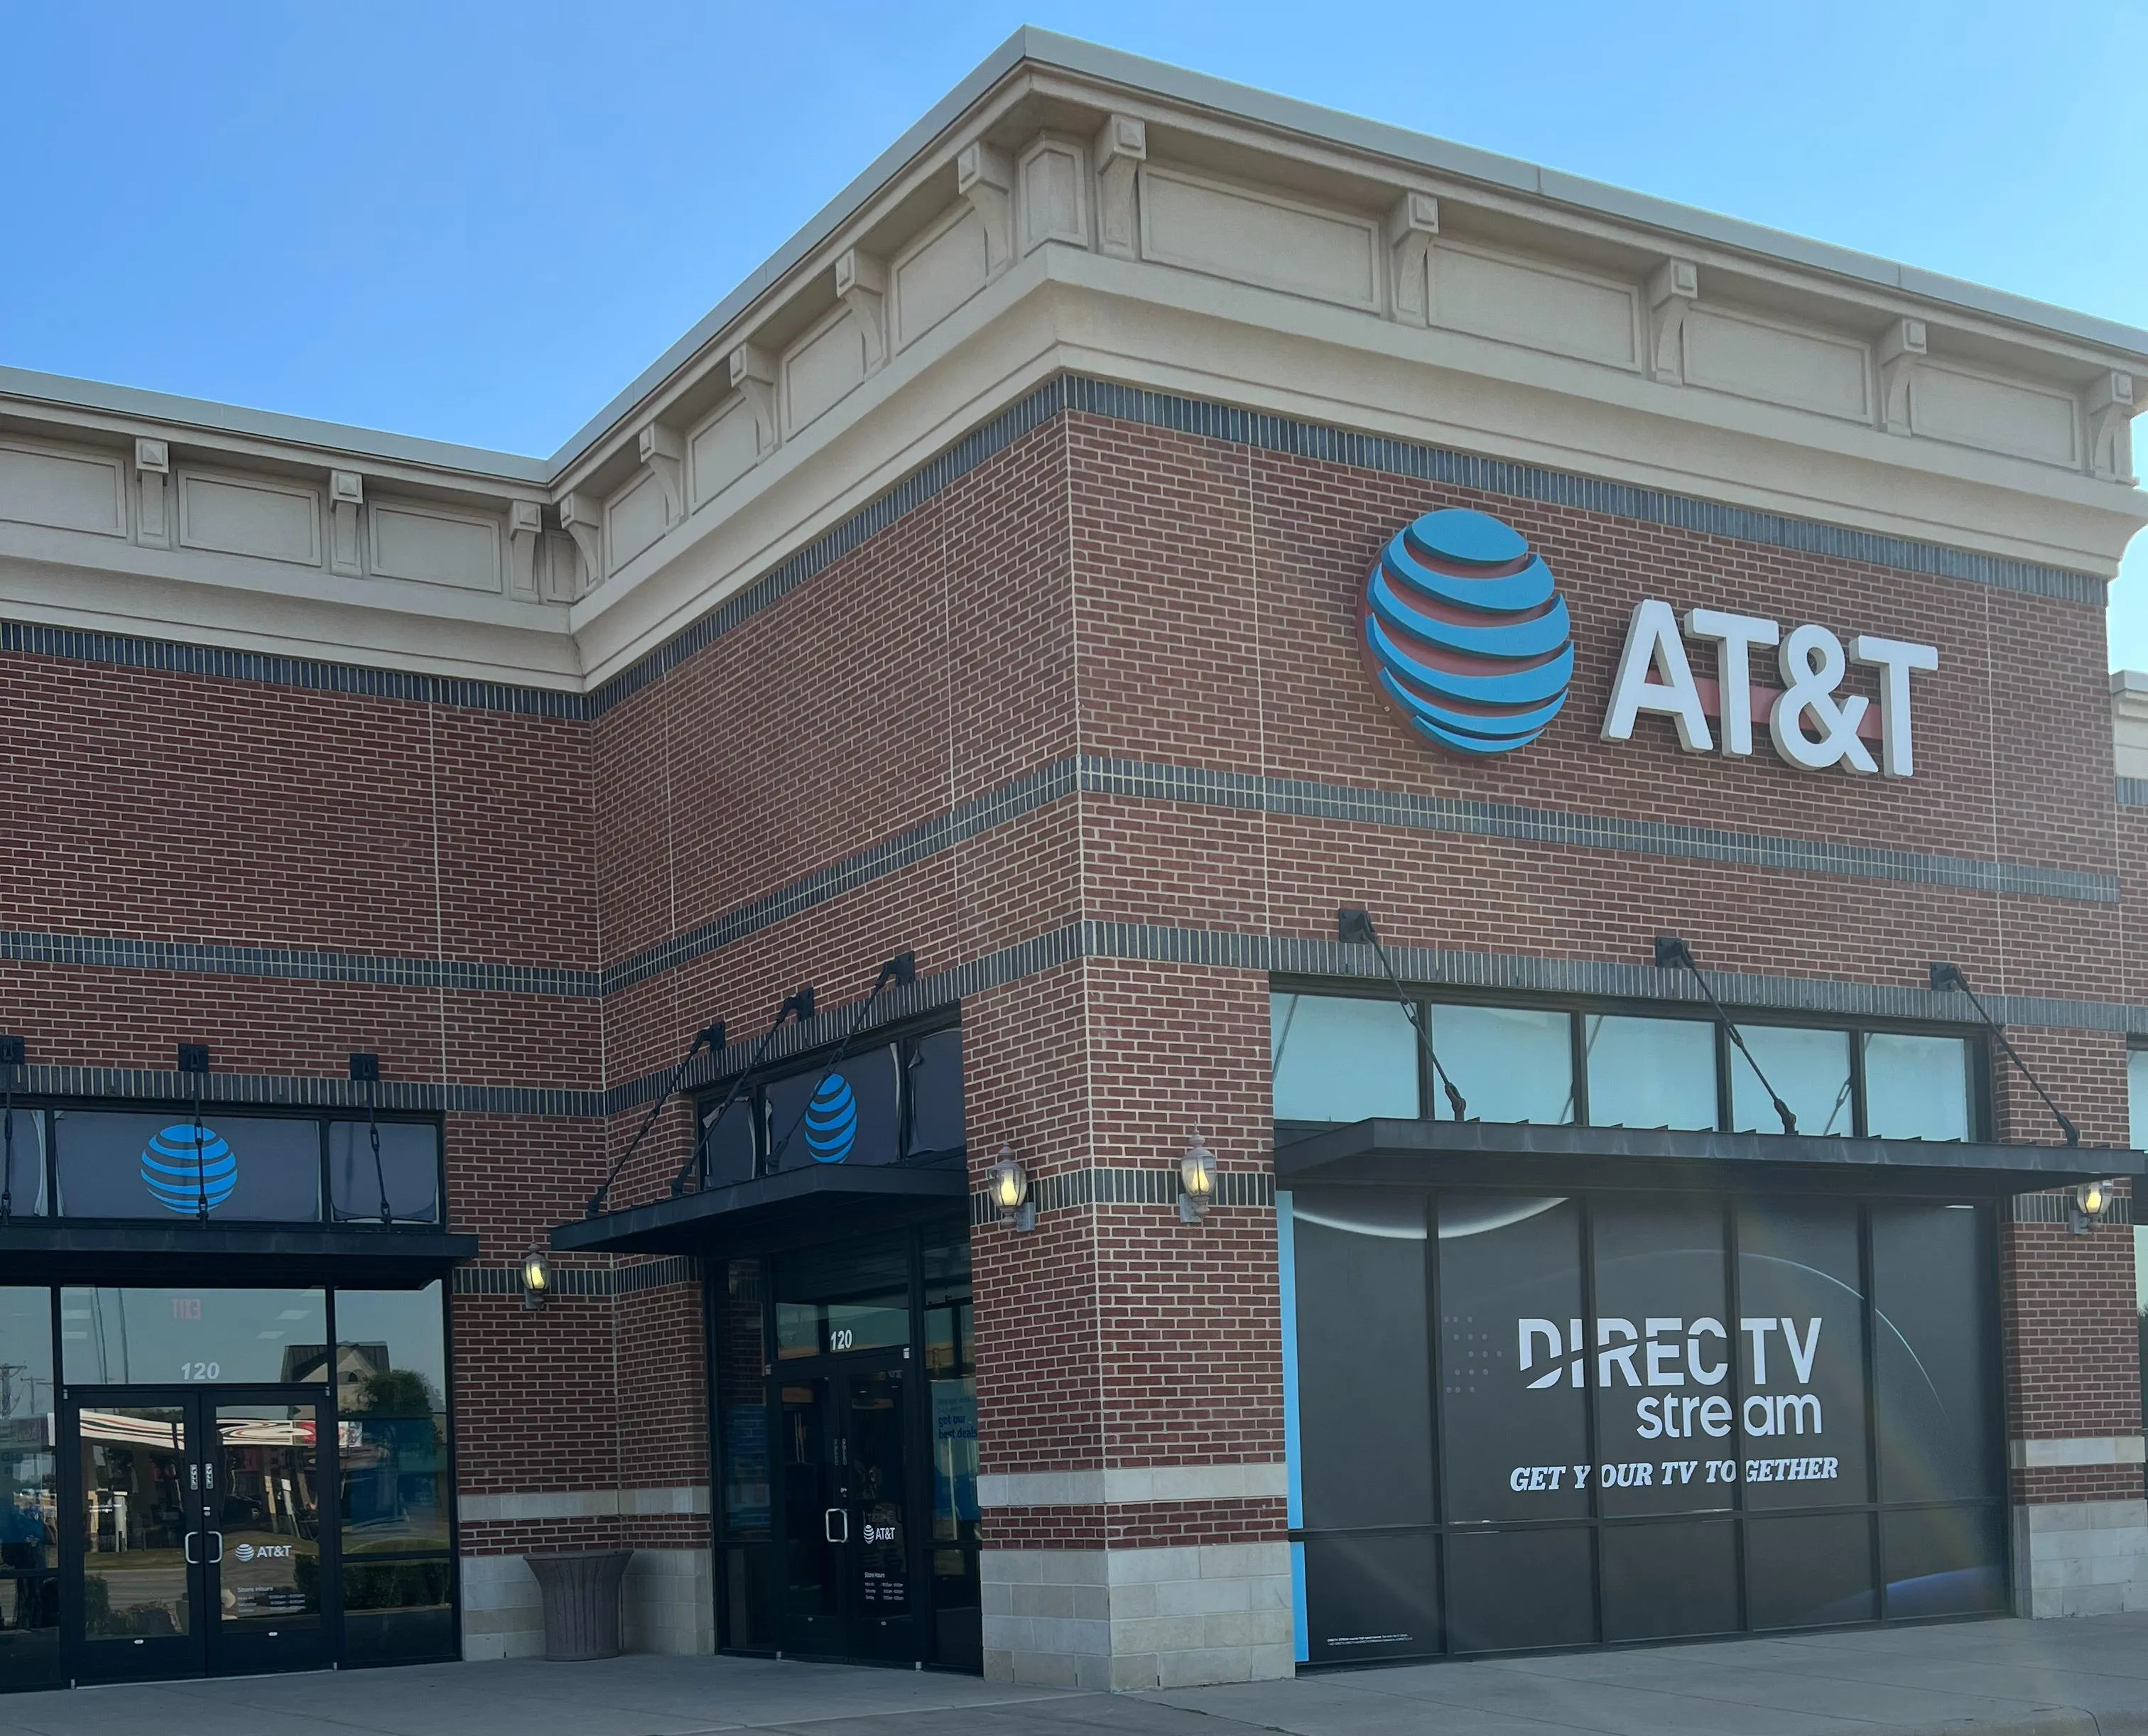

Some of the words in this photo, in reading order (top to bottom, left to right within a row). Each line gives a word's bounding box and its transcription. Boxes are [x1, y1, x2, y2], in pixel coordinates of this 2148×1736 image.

[1600, 599, 1938, 779] AT&T
[830, 1330, 852, 1351] 120
[1518, 1317, 1823, 1389] DIRECTV
[181, 1362, 220, 1380] 120
[938, 1415, 950, 1428] get
[953, 1415, 966, 1424] our
[1637, 1393, 1823, 1439] stream
[938, 1428, 955, 1439] best
[1509, 1466, 1567, 1492] GET
[1573, 1463, 1653, 1490] YOUR
[1660, 1460, 1698, 1485] TV
[1705, 1456, 1839, 1484] TOGETHER
[875, 1527, 896, 1541] AT&T
[256, 1545, 292, 1558] AT&T
